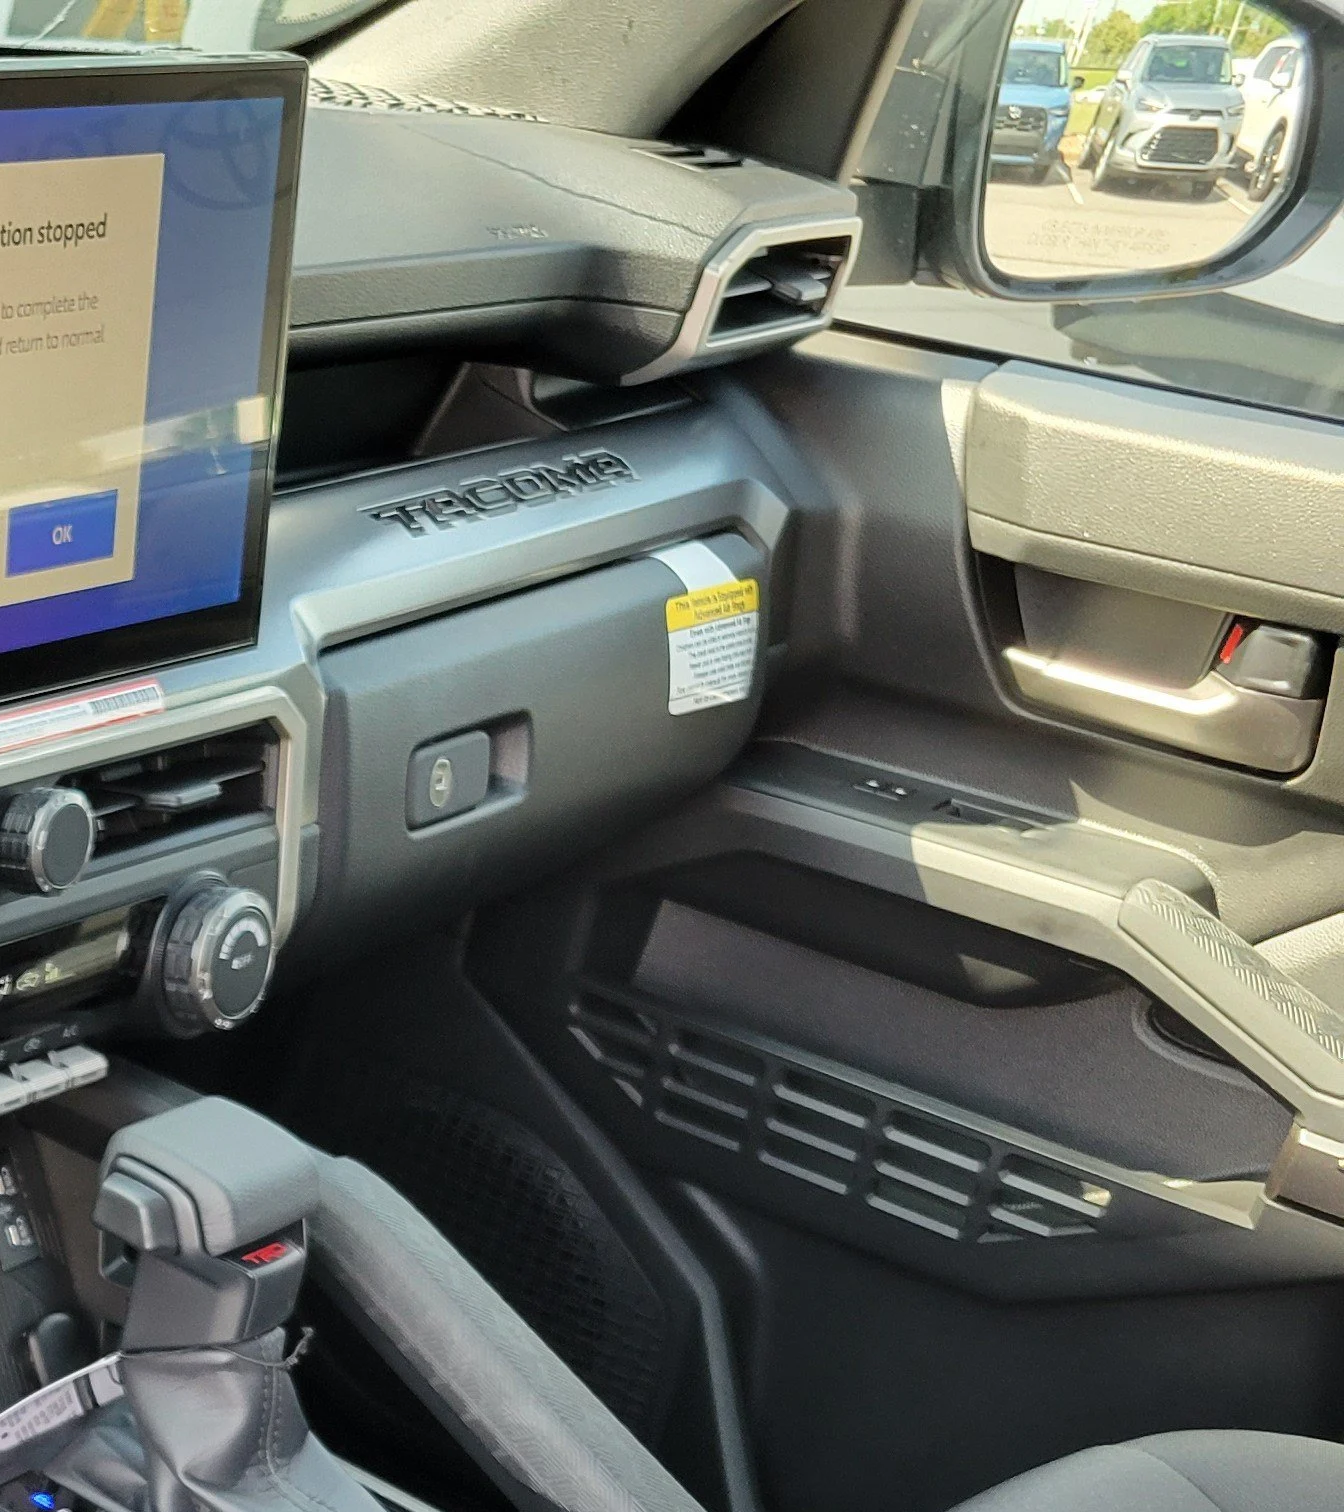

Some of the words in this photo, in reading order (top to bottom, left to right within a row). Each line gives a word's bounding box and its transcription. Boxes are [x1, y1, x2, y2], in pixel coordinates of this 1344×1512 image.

[37, 212, 108, 249] stopped
[1, 303, 14, 320] to
[17, 293, 76, 320] complete
[78, 291, 100, 311] the
[6, 335, 43, 354] return
[46, 332, 59, 350] to
[62, 324, 105, 347] normal
[357, 447, 641, 538] TACOMA
[51, 524, 73, 546] OK
